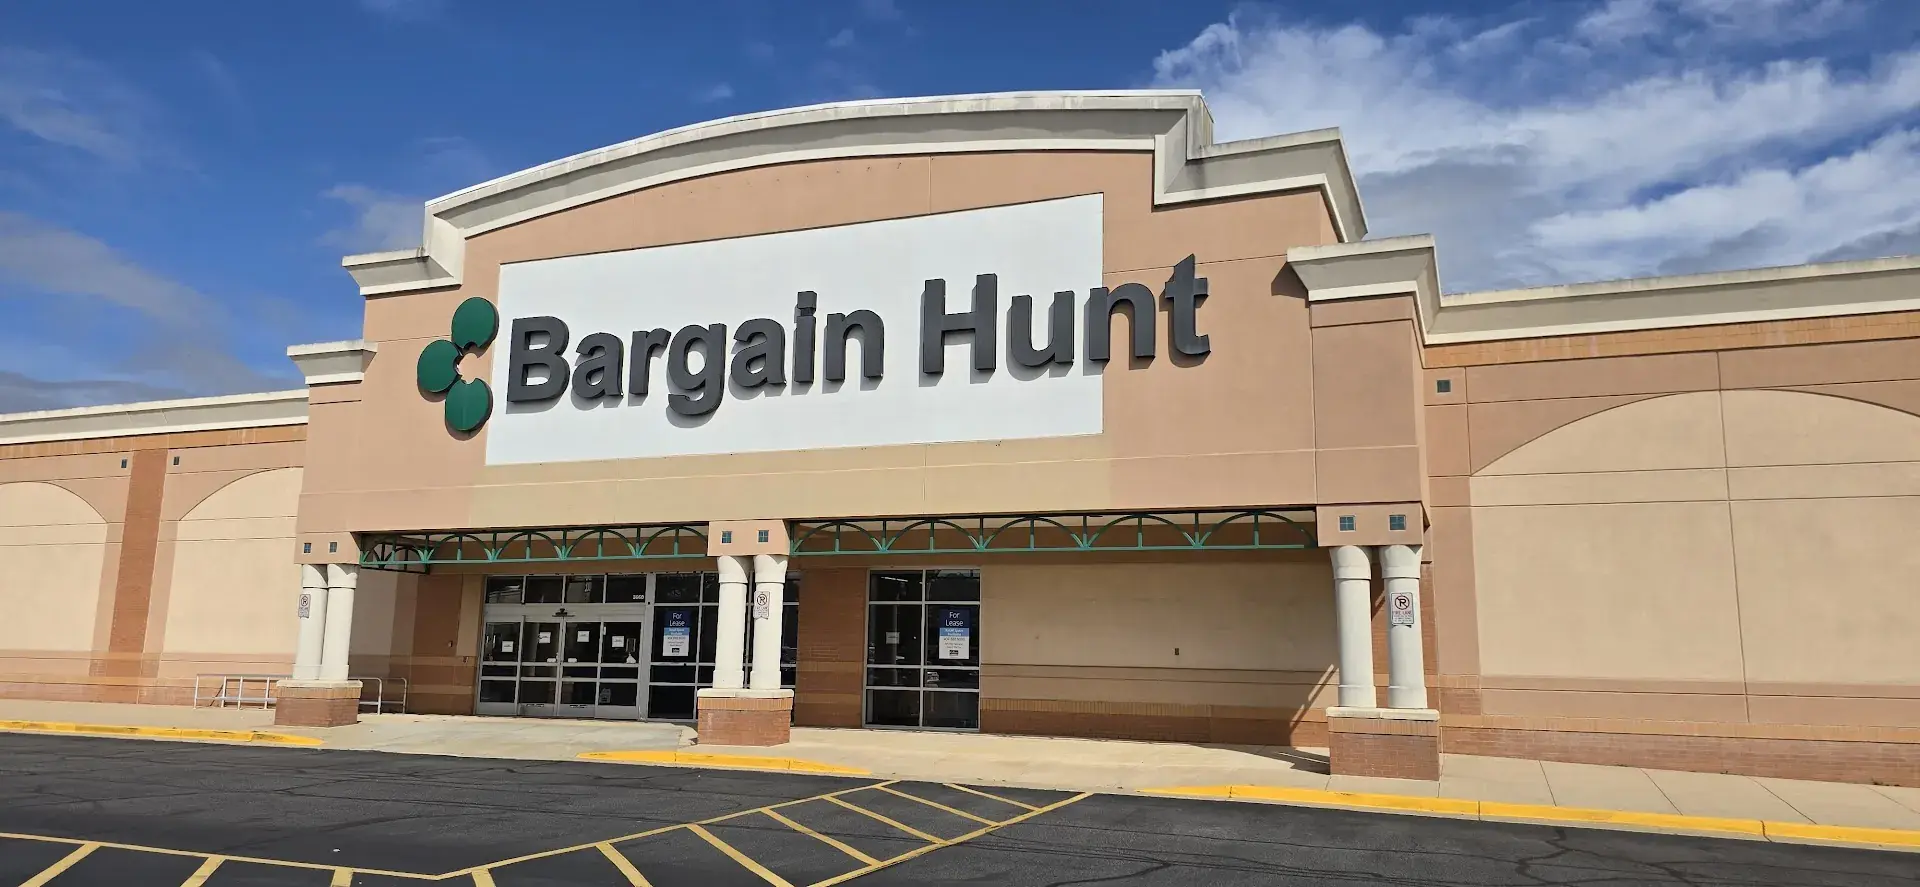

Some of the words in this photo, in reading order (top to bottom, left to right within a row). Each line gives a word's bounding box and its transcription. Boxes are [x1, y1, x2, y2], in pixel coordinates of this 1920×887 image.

[507, 290, 885, 416] Bargain
[922, 253, 1211, 376] Hunt
[949, 611, 960, 619] For
[945, 619, 963, 627] Lease
